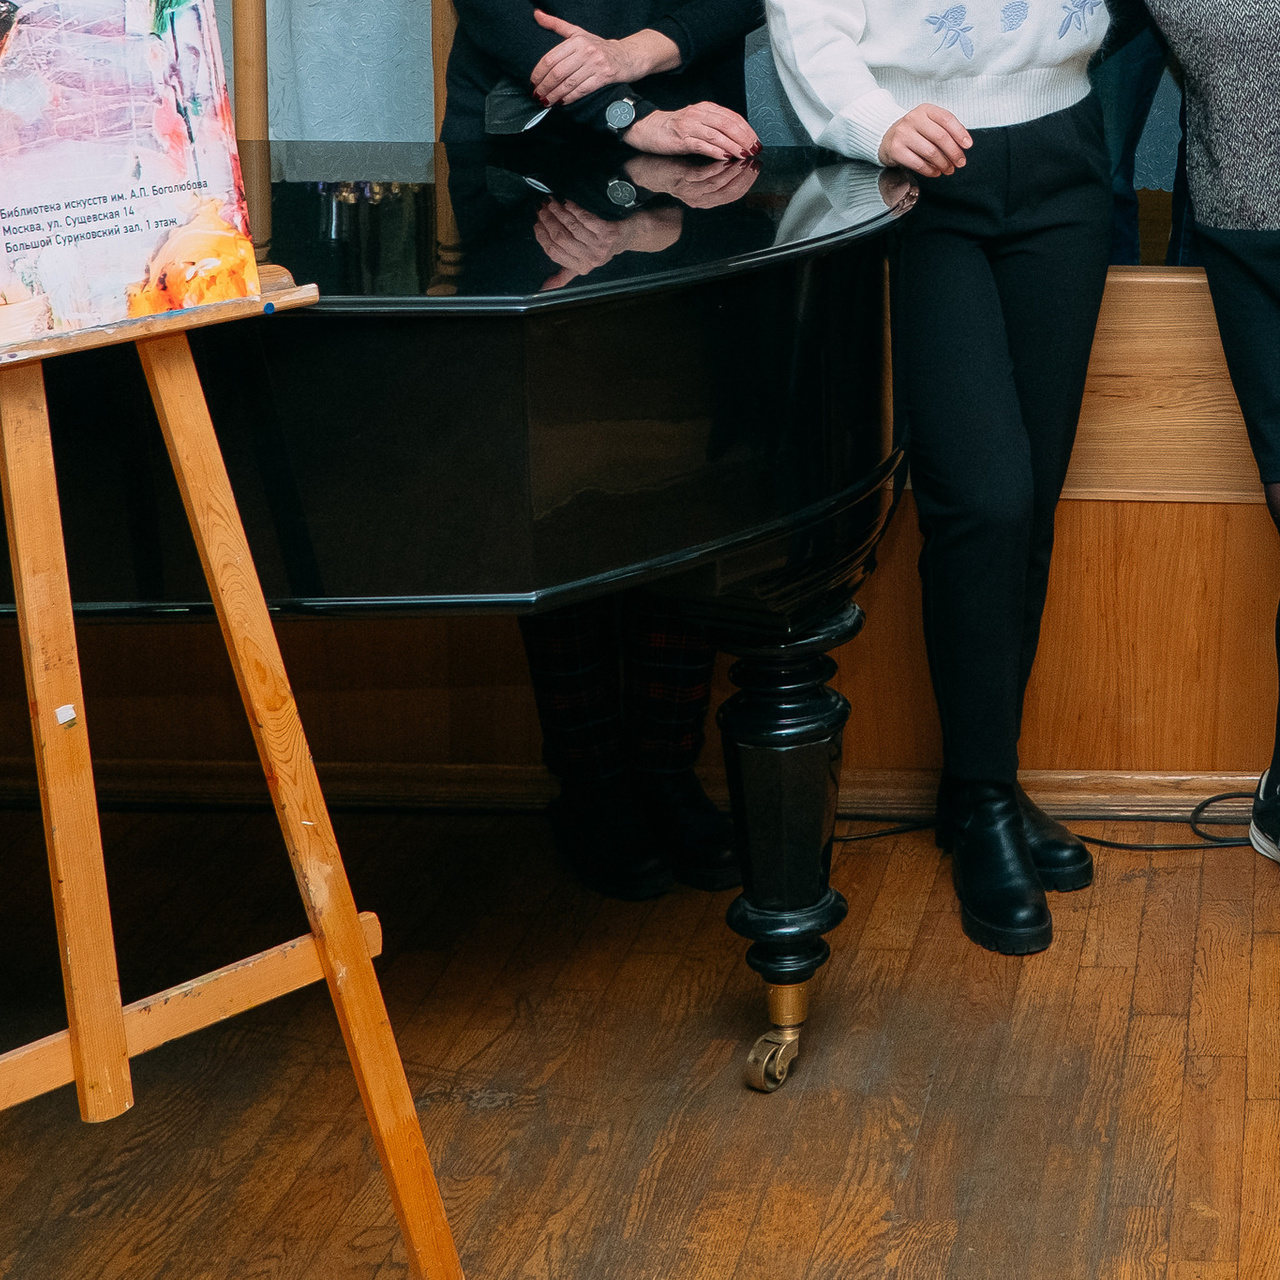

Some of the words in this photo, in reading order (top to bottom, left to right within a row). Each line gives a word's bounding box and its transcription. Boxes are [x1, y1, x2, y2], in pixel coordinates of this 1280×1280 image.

[0, 203, 62, 219] Библиотека
[64, 195, 108, 210] искусств
[110, 193, 127, 202] им.
[130, 187, 149, 200] А.П.
[151, 180, 208, 196] Боголюбова
[2, 222, 45, 236] Москва,
[47, 220, 63, 231] ул.
[65, 210, 120, 228] Сущевская
[123, 206, 135, 217] 14
[5, 236, 53, 253] Большой
[55, 225, 120, 246] Суриковский
[123, 224, 144, 234] зал,
[146, 220, 151, 230] 1
[154, 218, 178, 229] этаж
